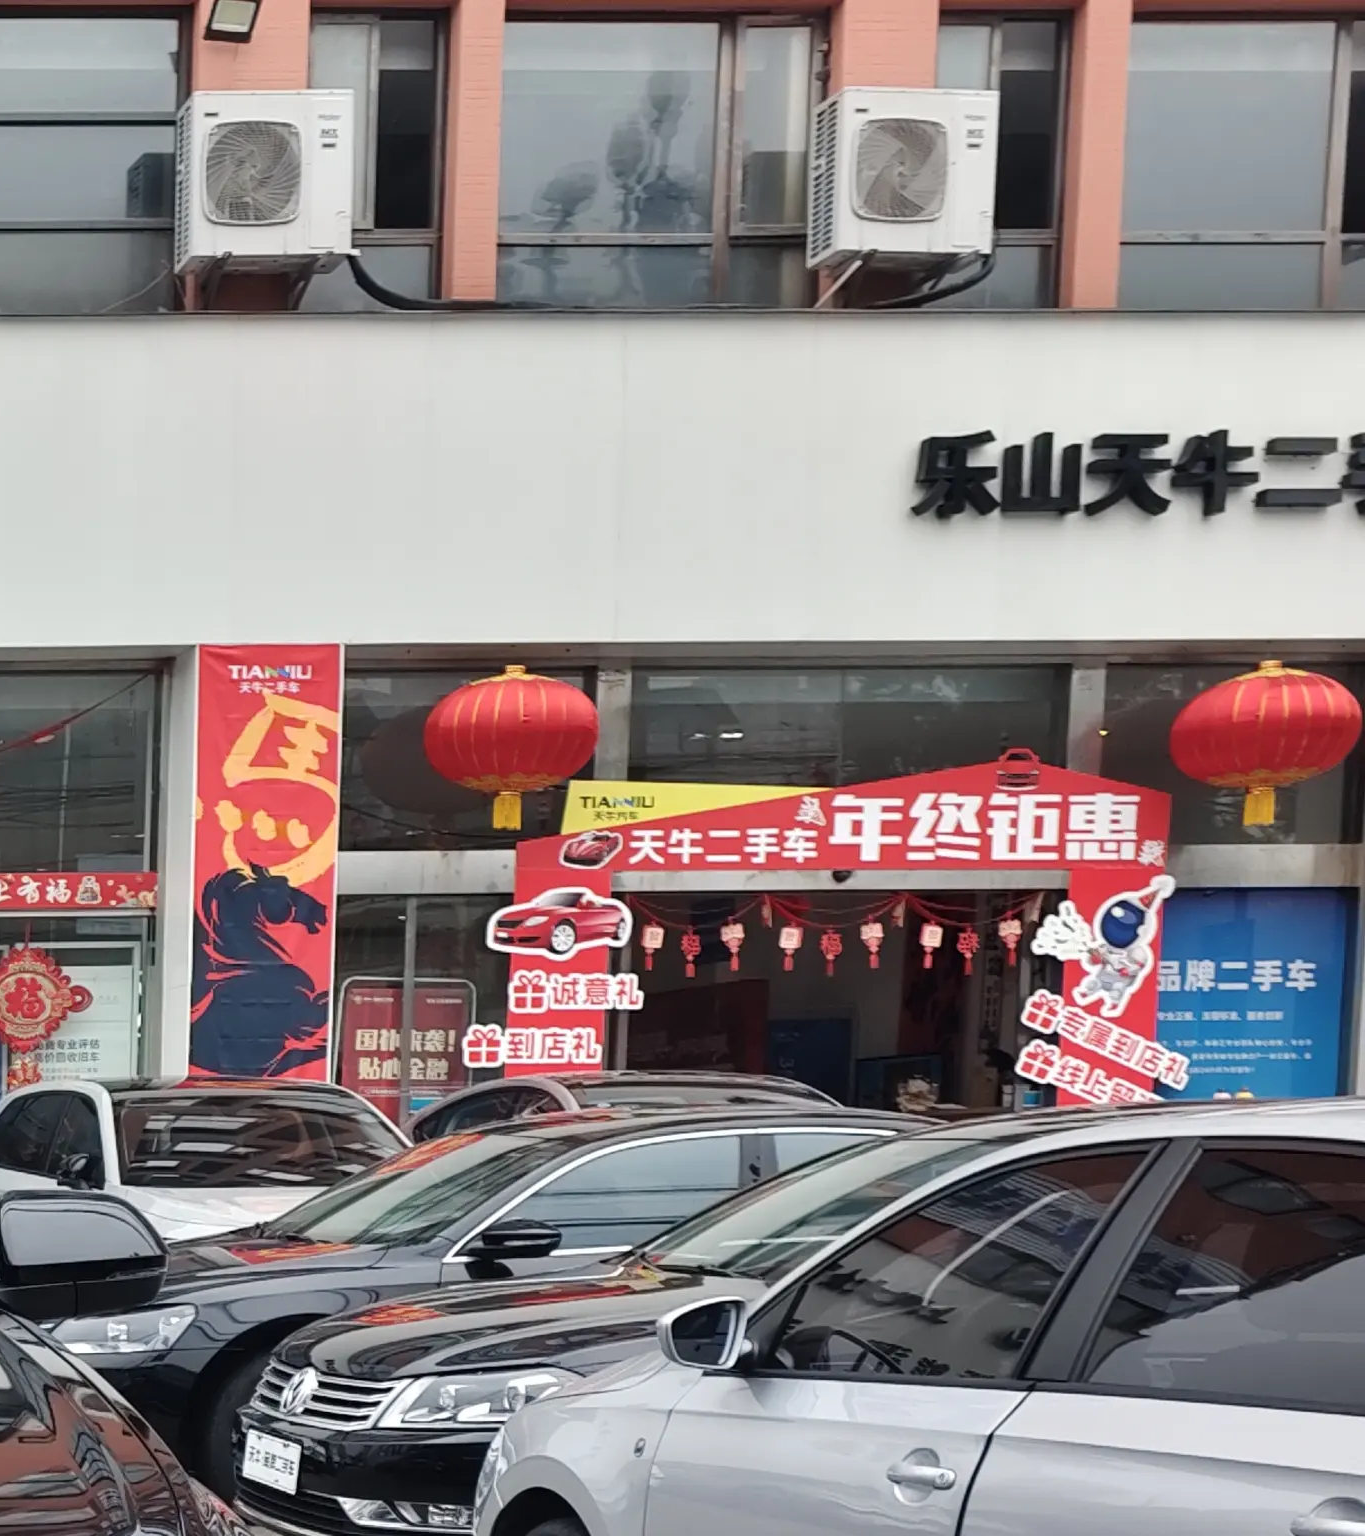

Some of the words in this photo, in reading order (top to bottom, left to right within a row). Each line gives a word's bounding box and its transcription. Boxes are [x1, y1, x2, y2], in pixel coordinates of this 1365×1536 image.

[629, 828, 818, 865] 天牛二手车
[552, 977, 642, 1006] 诚意礼
[1157, 959, 1317, 992] 品牌二手车
[506, 1031, 598, 1060] 到店礼
[1058, 1013, 1187, 1087] 专属到店礼
